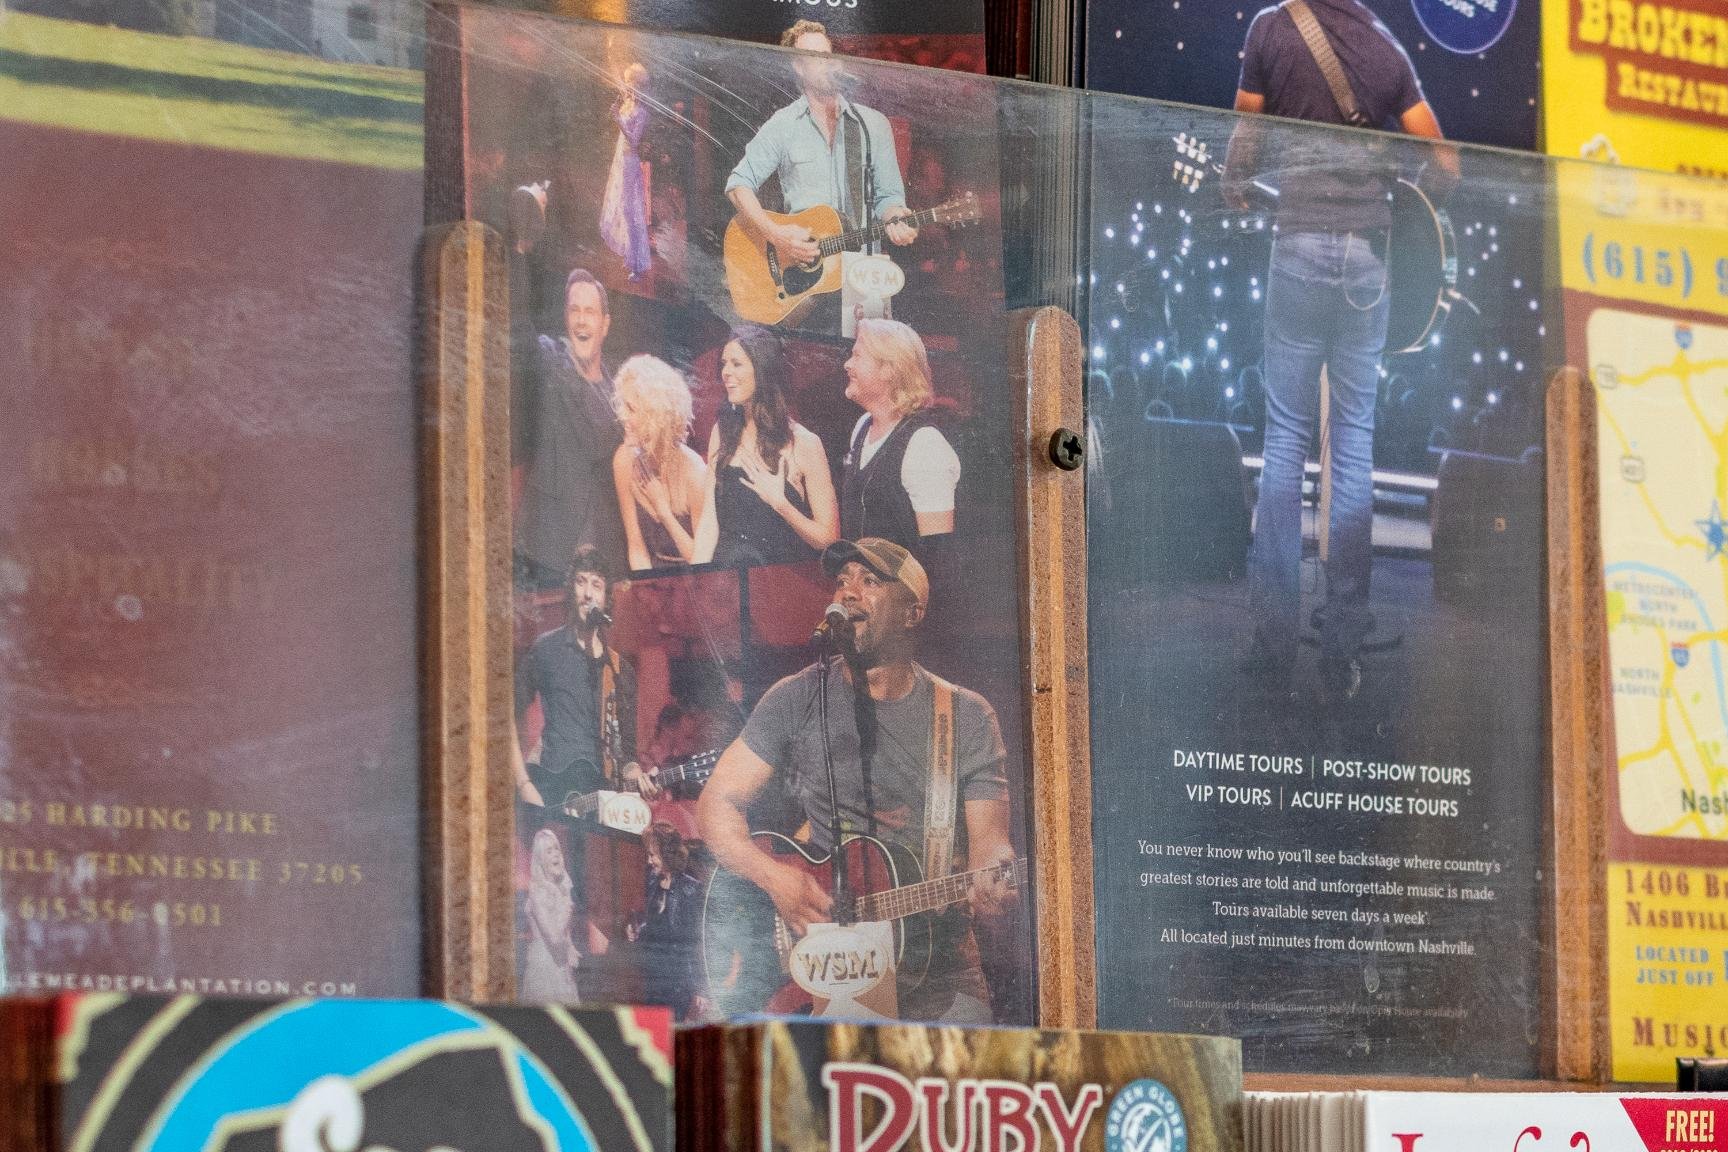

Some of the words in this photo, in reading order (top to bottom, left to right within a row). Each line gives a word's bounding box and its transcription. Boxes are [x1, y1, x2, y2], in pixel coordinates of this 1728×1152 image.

[1580, 232, 1695, 299] (615)
[1173, 750, 1246, 772] DAYTIME
[1249, 754, 1304, 776] TOURS
[1323, 758, 1417, 782] POST-SHOW
[1420, 765, 1473, 787] TOURS
[1186, 783, 1214, 802] VIP
[1217, 785, 1273, 807] TOURS
[1291, 790, 1344, 811] ACUFF
[1347, 794, 1404, 815] HOUSE
[1406, 797, 1459, 818] TOURS
[46, 803, 192, 833] HARDING
[206, 809, 279, 836] PIKE
[1138, 839, 1164, 857] You
[1166, 844, 1205, 859] never
[1206, 842, 1244, 861] know
[1246, 845, 1275, 862] who
[1278, 847, 1313, 866] you'll
[1315, 851, 1336, 865] see
[1338, 849, 1402, 871] backstage
[1403, 854, 1442, 872] where
[1444, 858, 1502, 877] country's
[1140, 870, 1192, 888] greatest
[1195, 872, 1239, 890] stories
[1241, 877, 1263, 891] are
[1265, 874, 1290, 892] told
[1292, 877, 1318, 893] and
[1320, 876, 1405, 899] unforgettable
[1406, 881, 1445, 899] music
[1447, 882, 1459, 899] is
[1624, 868, 1690, 898] 1406
[1212, 900, 1250, 919] Tours
[1252, 902, 1310, 922] available
[1311, 907, 1349, 923] seven
[1350, 906, 1381, 926] days
[1382, 911, 1391, 924] a
[1160, 927, 1179, 945] All
[1181, 928, 1229, 947] located
[1229, 930, 1256, 951] just
[1257, 931, 1312, 950] minutes
[1313, 932, 1346, 951] from
[1347, 936, 1415, 955] downtown
[1418, 938, 1477, 957] Nashville.
[1634, 944, 1710, 965] LOCATED
[797, 950, 881, 982] WSM
[1635, 966, 1681, 986] JUST
[1685, 968, 1716, 987] OFF
[1665, 1108, 1715, 1143] FREE!
